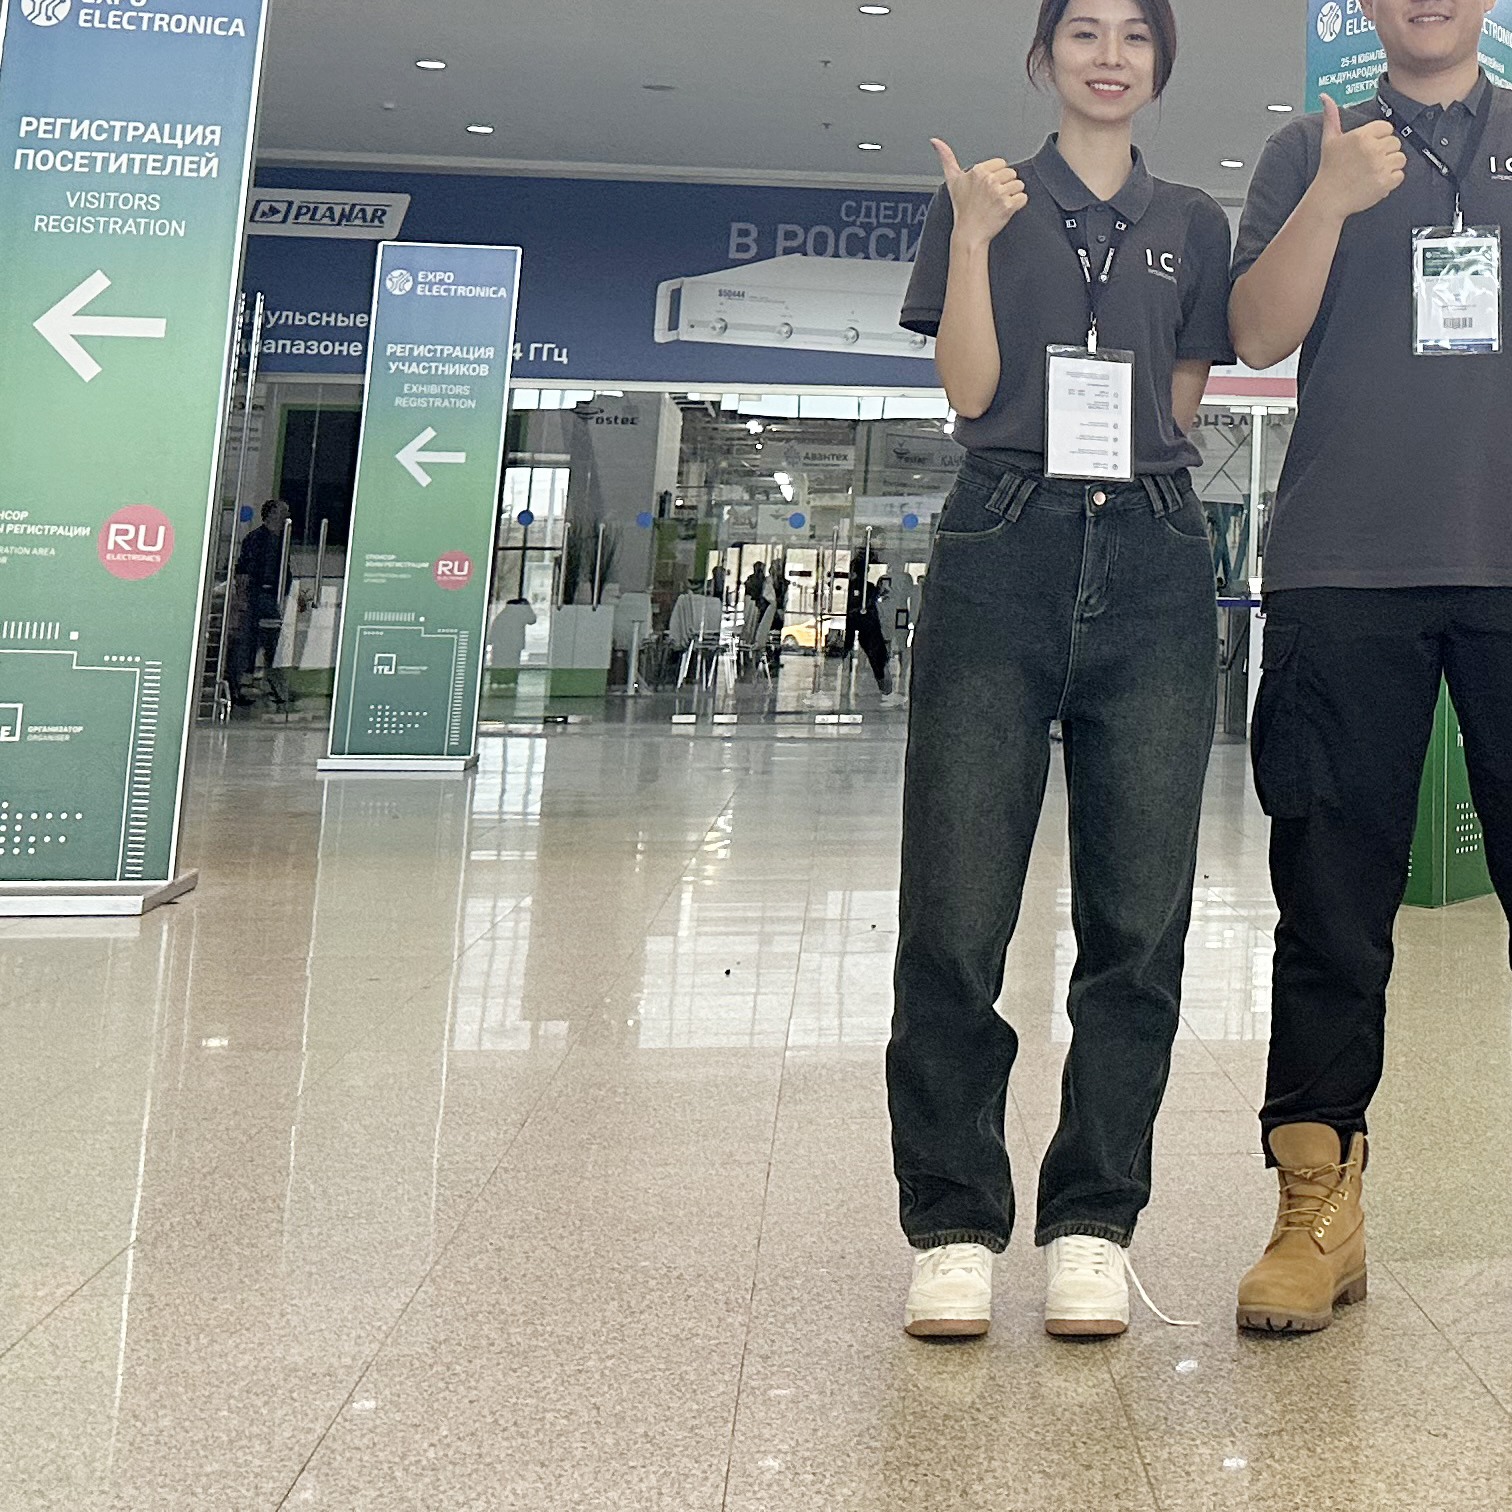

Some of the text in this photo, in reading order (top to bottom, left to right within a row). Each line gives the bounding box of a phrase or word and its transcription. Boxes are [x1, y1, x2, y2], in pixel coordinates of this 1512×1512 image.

[79, 9, 246, 37] ELECTRONICA
[19, 117, 222, 150] РЕГИСТРАЦИЯ
[14, 148, 220, 178] ПОСЕТИТЕЛЕЙ
[66, 191, 161, 211] VISITORS
[291, 201, 393, 227] PLANAR
[34, 215, 186, 237] REGISTRATION
[728, 222, 759, 260] В
[418, 272, 454, 283] EXPO
[416, 284, 507, 298] ELECTRONICA
[386, 343, 495, 360] РЕГИСТРАЦИЯ
[528, 343, 568, 364] ГГц
[388, 361, 489, 377] УЧАСТНИКОВ
[403, 382, 470, 396] EXHIBITORS
[395, 396, 476, 410] REGISTRATION
[6, 523, 91, 538] РЕГИСТРАЦИИ
[107, 523, 166, 552] RU
[437, 560, 470, 576] RU
